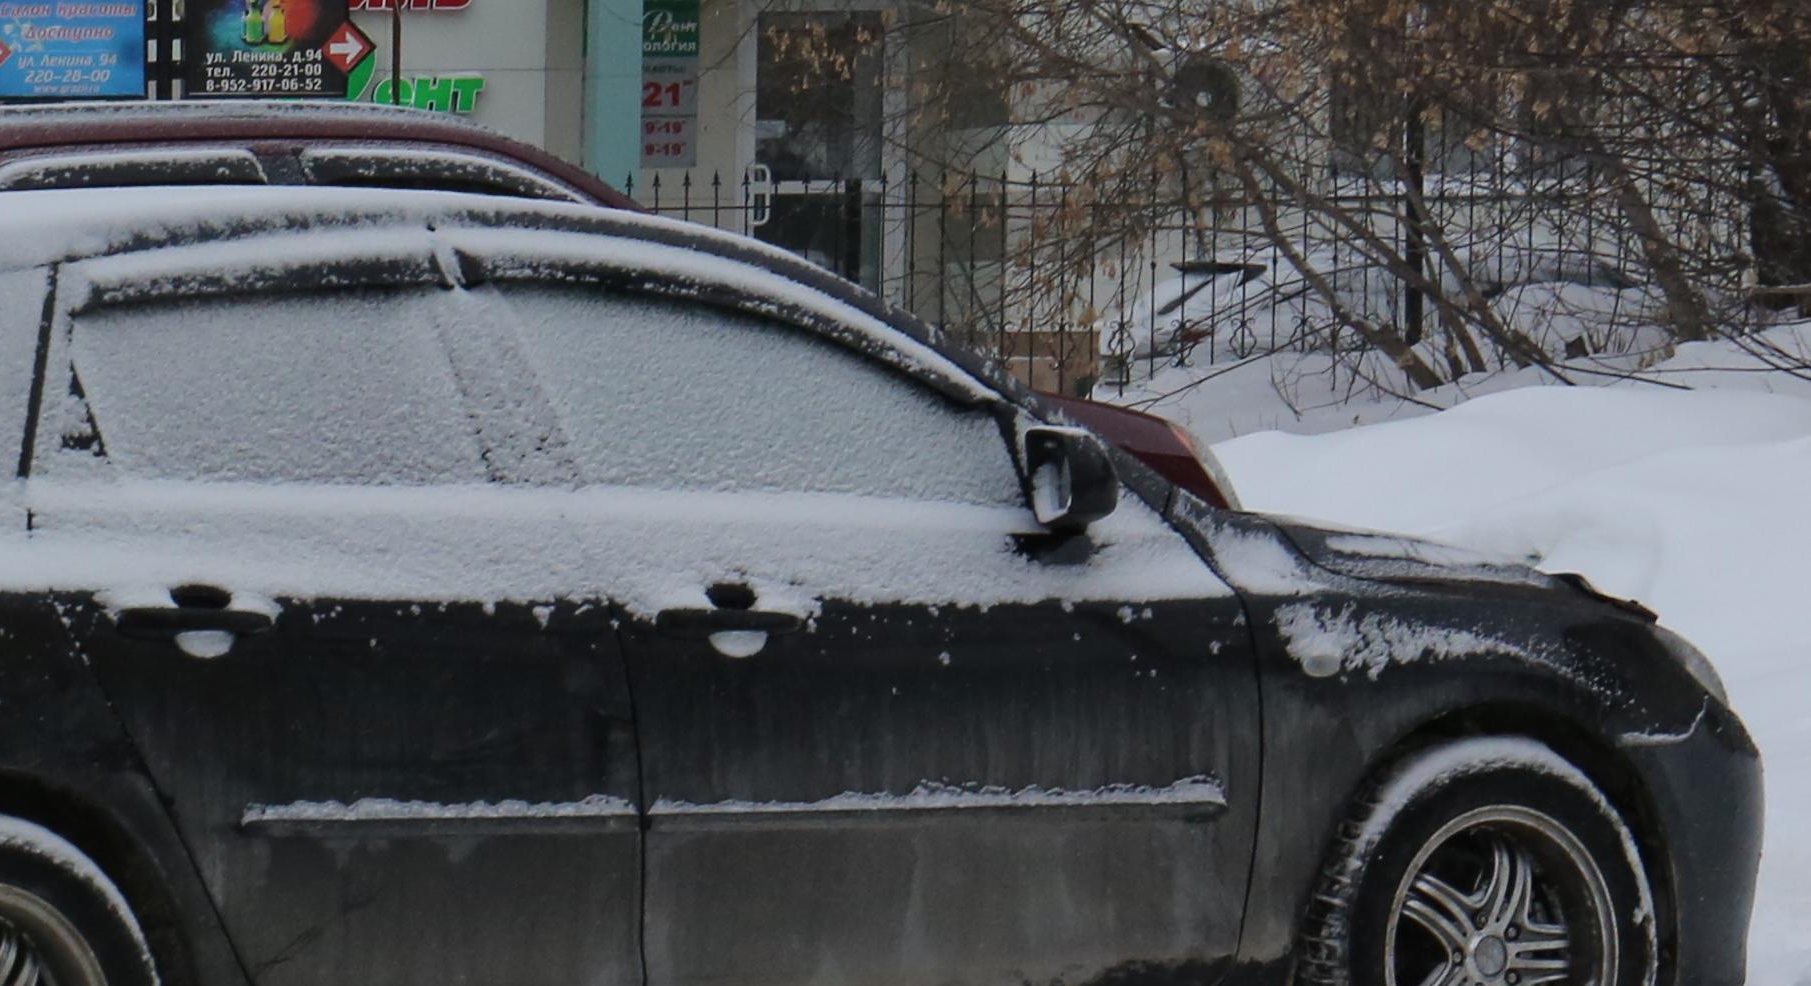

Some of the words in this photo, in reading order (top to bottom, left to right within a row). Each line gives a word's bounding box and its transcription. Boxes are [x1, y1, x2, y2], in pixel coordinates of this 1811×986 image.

[99, 53, 118, 66] 94
[205, 52, 227, 65] ул.
[205, 66, 235, 77] тел.
[251, 63, 322, 77] 220-21-00
[205, 78, 322, 92] 8-952-917-06-52
